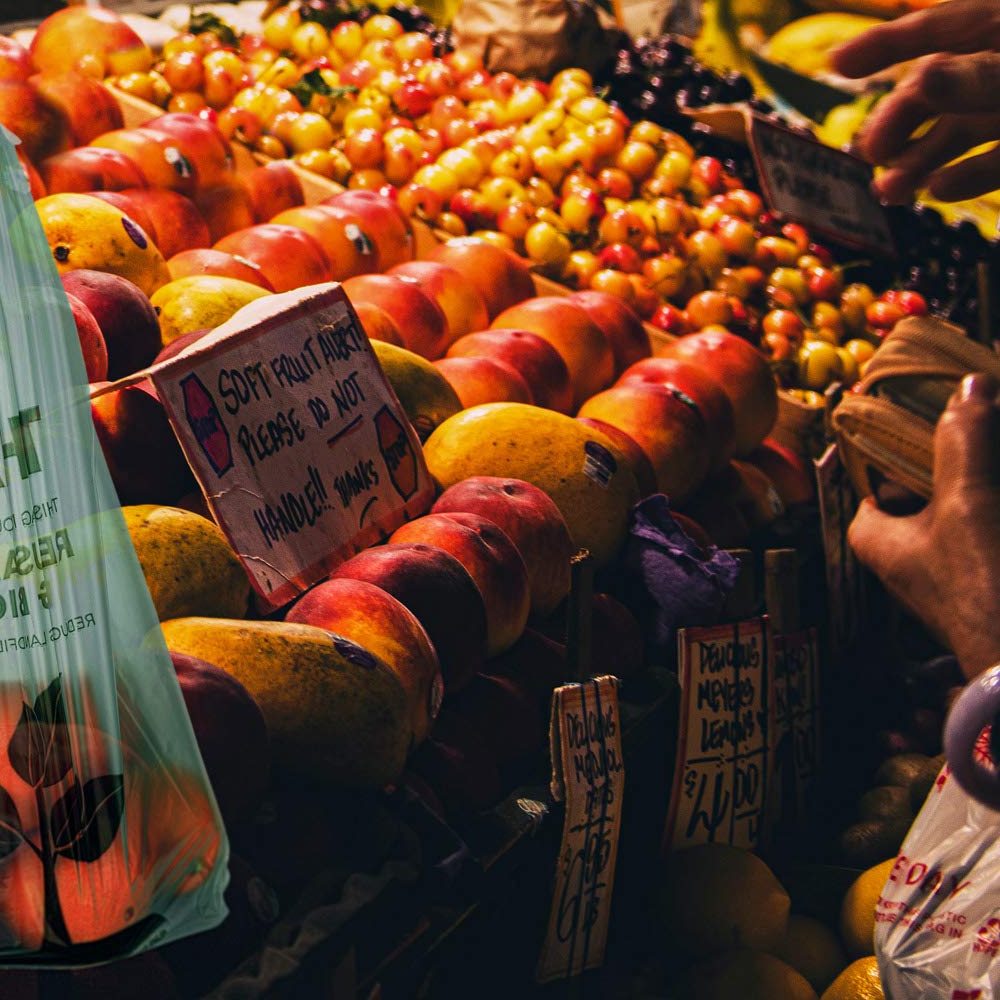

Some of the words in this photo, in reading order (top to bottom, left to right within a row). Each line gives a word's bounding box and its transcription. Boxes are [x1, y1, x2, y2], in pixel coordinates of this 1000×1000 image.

[217, 361, 272, 416] SOFT
[269, 338, 322, 389] FRUIT
[237, 407, 306, 466] PLEASE
[307, 396, 330, 430] DO
[331, 372, 366, 417] NOT
[948, 926, 964, 939] IN
